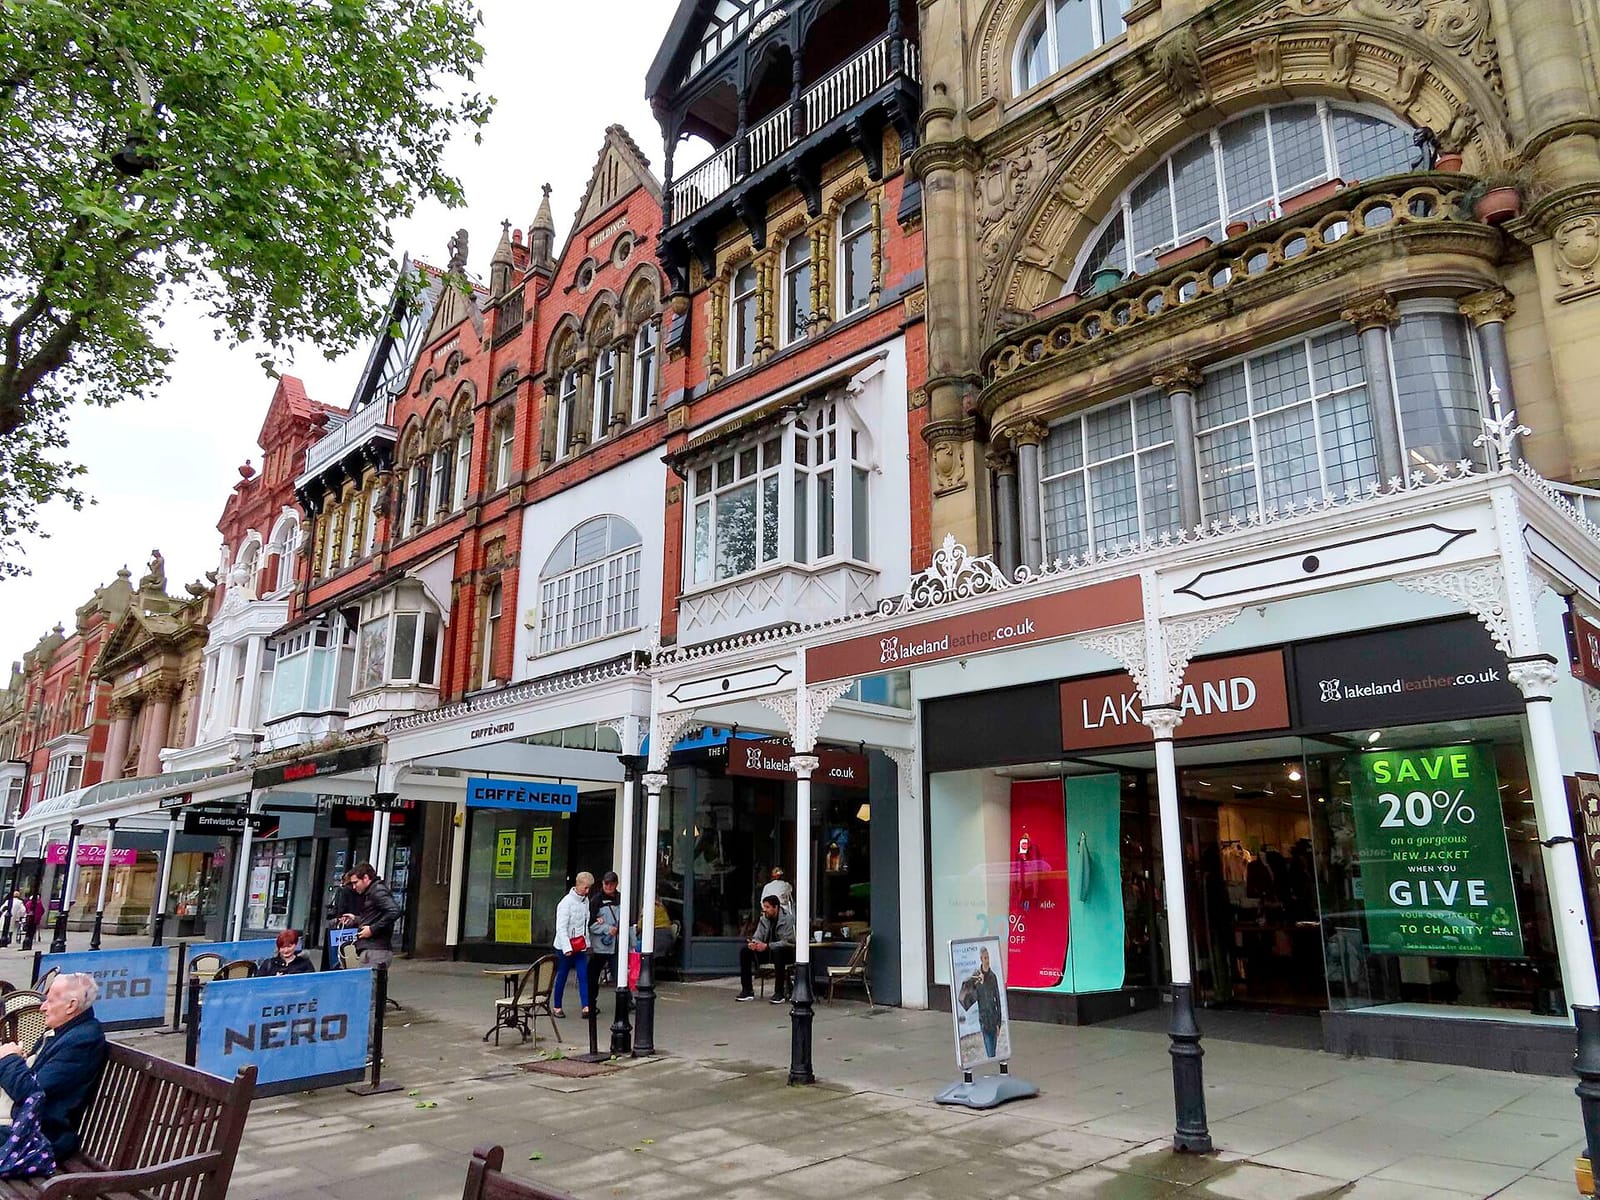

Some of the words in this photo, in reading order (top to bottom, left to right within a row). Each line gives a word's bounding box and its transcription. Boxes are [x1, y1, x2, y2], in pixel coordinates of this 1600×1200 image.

[1082, 676, 1257, 729] LAKAND
[1372, 754, 1470, 784] SAVE
[528, 792, 572, 805] NERO
[1378, 790, 1475, 828] 20%
[199, 816, 235, 826] Entwistle
[503, 837, 512, 846] TO
[538, 835, 547, 844] TO
[1390, 837, 1404, 845] on
[1407, 837, 1414, 845] a
[1416, 835, 1468, 846] gorgeous
[501, 848, 512, 856] LET
[536, 846, 548, 855] LET
[1393, 851, 1419, 860] NEW
[1423, 850, 1470, 860] JACKET
[1408, 865, 1434, 873] WHEN
[1388, 880, 1489, 907] GIVE
[503, 897, 512, 907] TO
[512, 897, 523, 907] LET
[1400, 925, 1418, 934] TO
[1423, 925, 1484, 935] CHARITY
[1009, 935, 1025, 944] OFF
[224, 1013, 348, 1056] NERO
